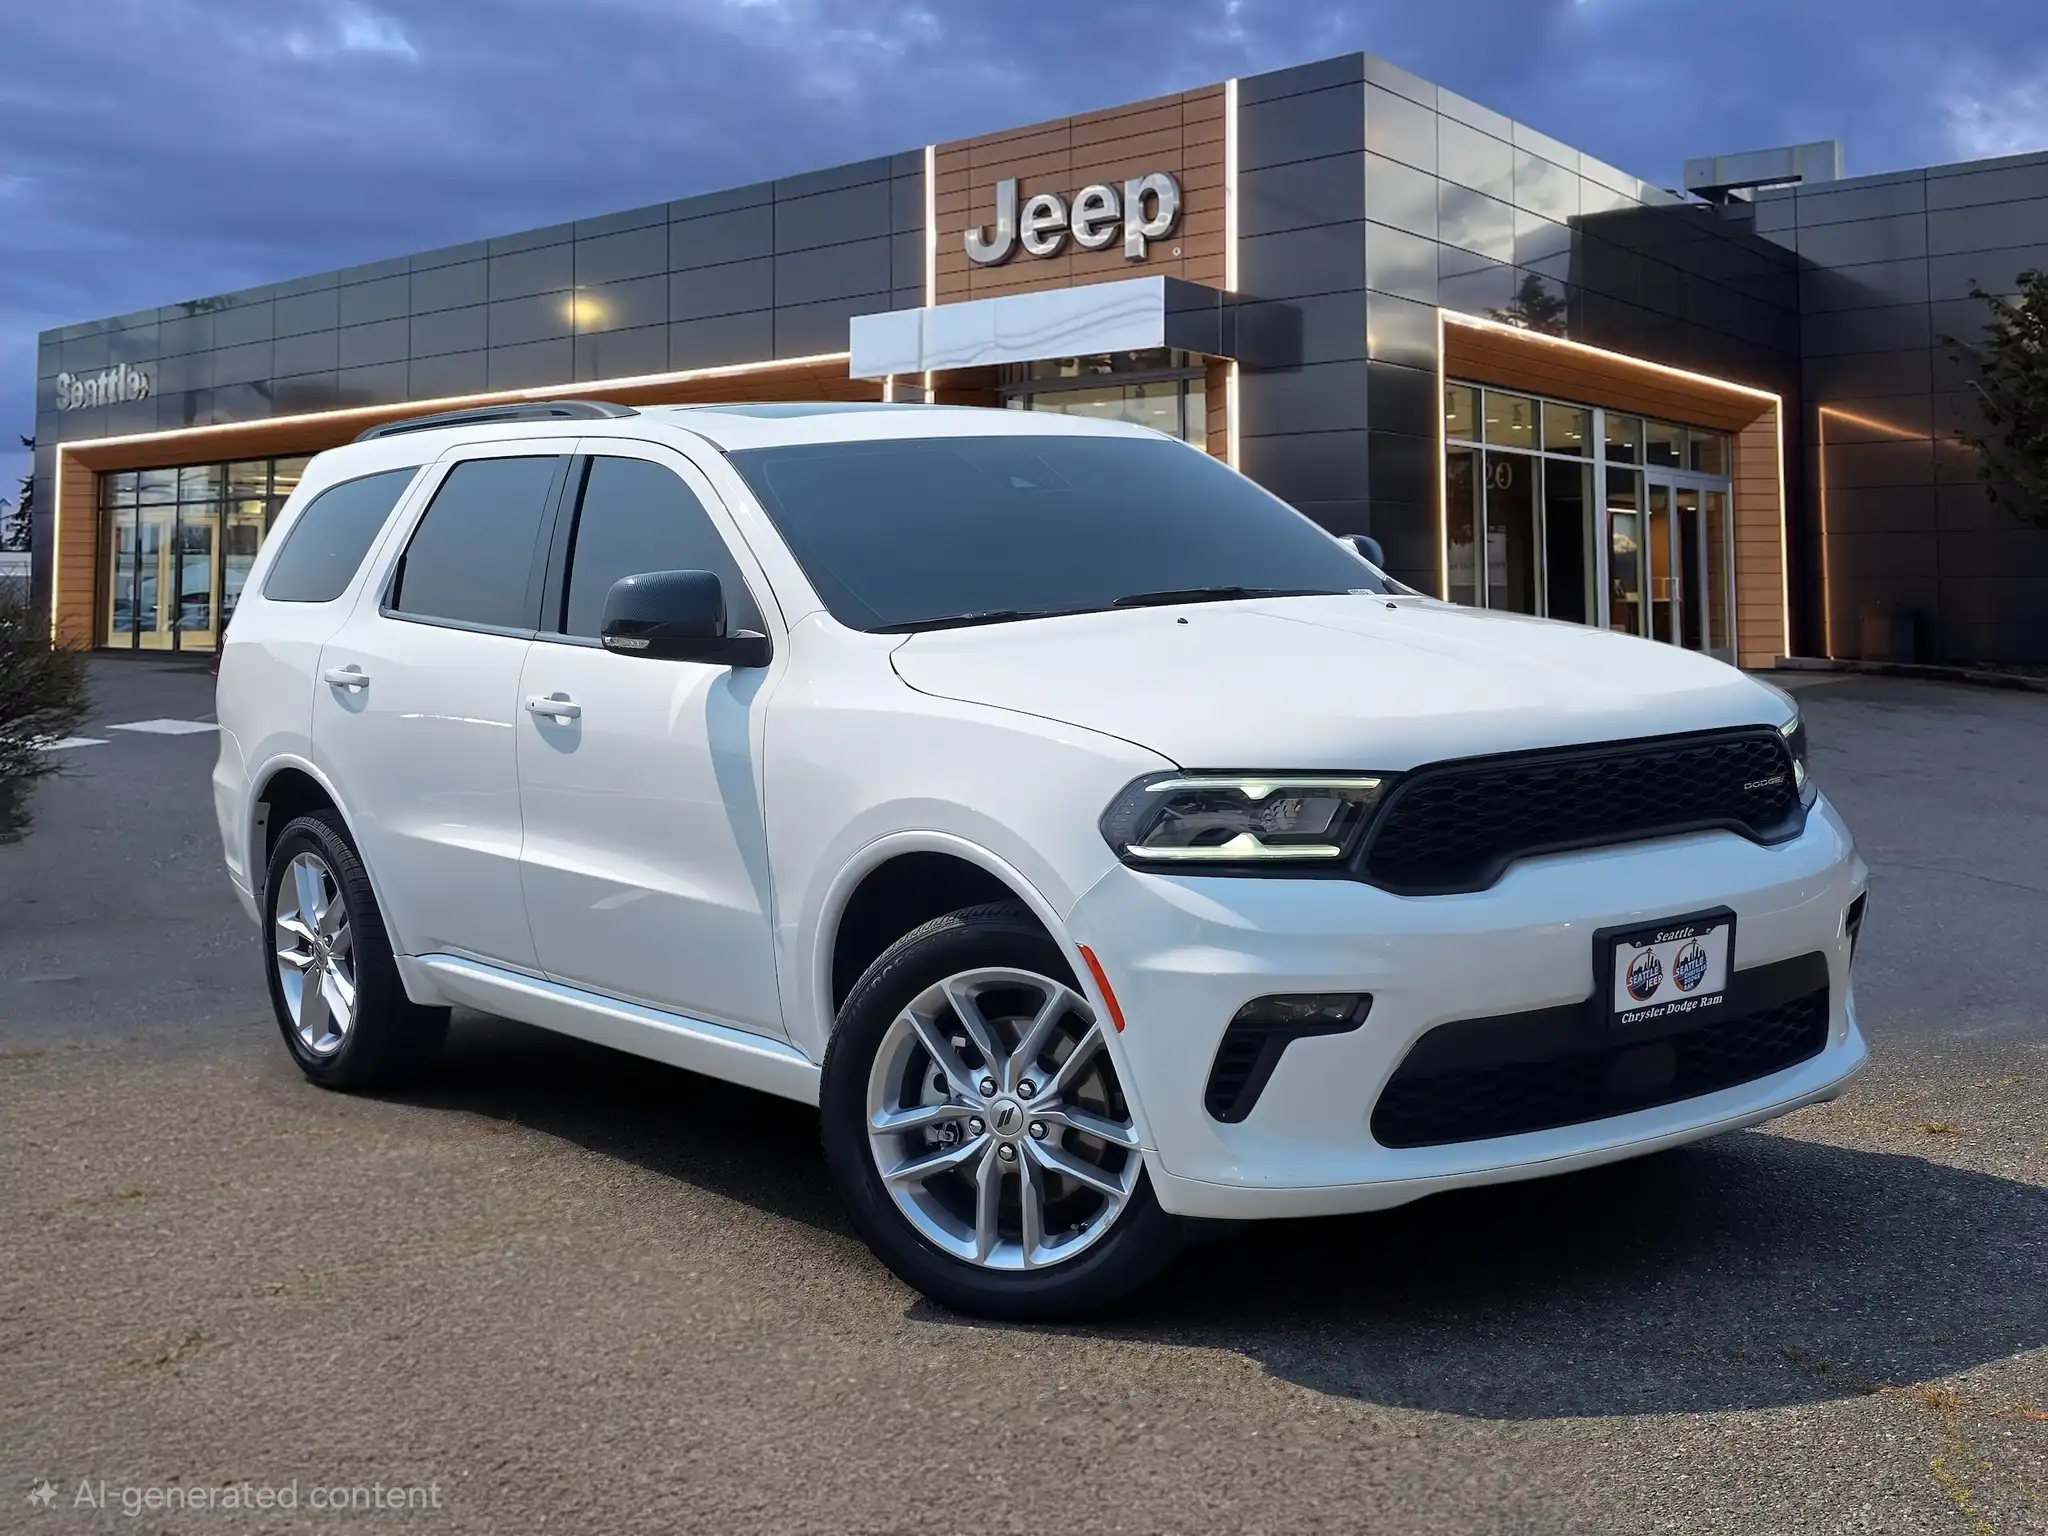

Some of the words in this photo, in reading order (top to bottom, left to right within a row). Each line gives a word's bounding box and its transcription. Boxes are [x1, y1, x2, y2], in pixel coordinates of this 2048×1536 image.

[964, 171, 1182, 267] Jeep
[56, 362, 149, 411] Seattle
[1654, 926, 1695, 943] Seattle
[1628, 967, 1661, 986] SEATTLE
[1676, 957, 1705, 977] SEATTLE
[1645, 975, 1663, 991] JEEP
[1621, 1007, 1665, 1024] Chrysler
[1666, 999, 1698, 1015] Dodge
[1700, 995, 1723, 1008] Ram
